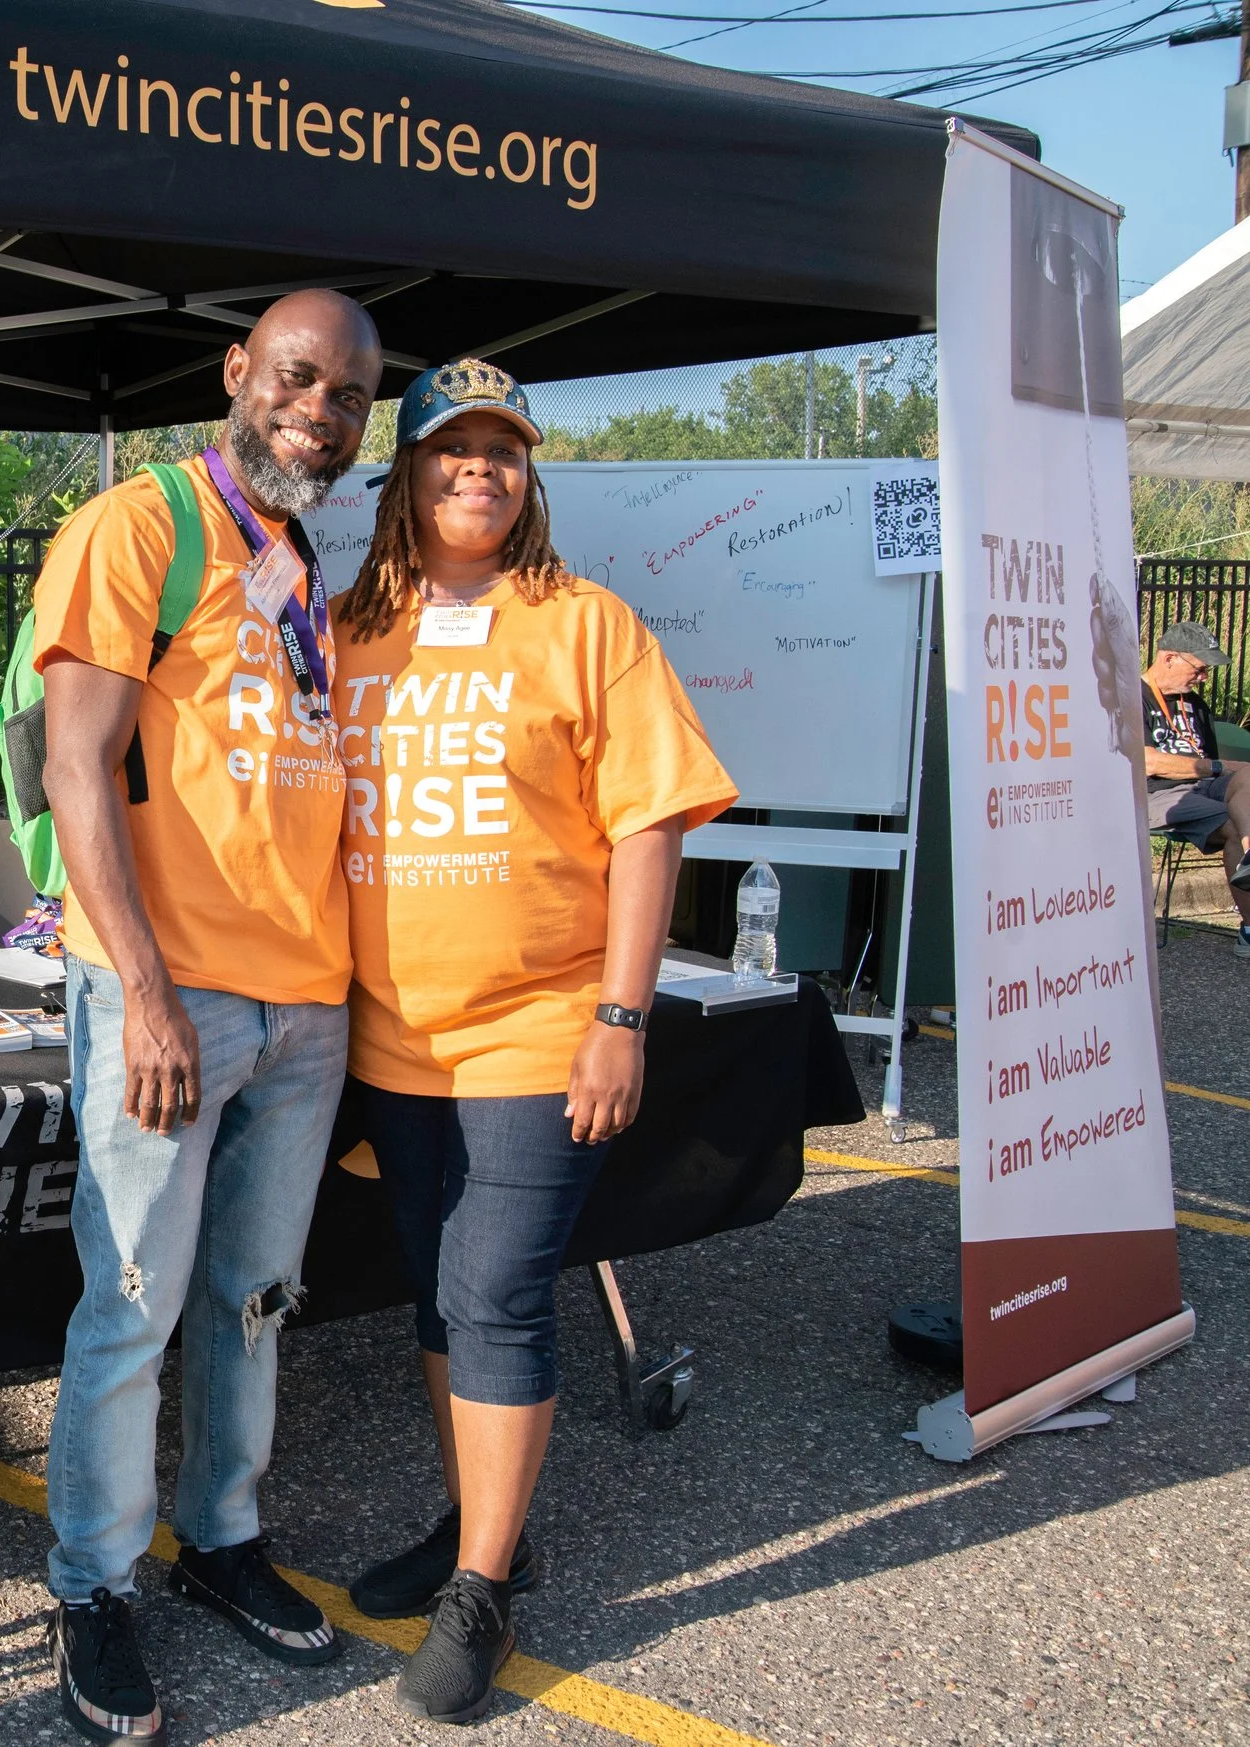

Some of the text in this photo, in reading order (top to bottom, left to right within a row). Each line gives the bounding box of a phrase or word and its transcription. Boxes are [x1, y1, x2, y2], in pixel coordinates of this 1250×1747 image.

[9, 46, 598, 210] twincitiesrise.org
[982, 534, 1065, 605] TWIN
[346, 672, 514, 716] TWIN
[985, 679, 1072, 763] R!SE
[349, 773, 509, 838] R!SE
[1008, 780, 1073, 801] EMPOWERMENT
[1008, 799, 1074, 825] INSTITUTE
[383, 850, 510, 868] EMPOWERMENT
[383, 866, 511, 886] INSTITUTE
[996, 896, 1026, 931] am
[1031, 867, 1116, 925] Loveable
[998, 979, 1028, 1016] am
[1036, 948, 1134, 1009] Important
[999, 1061, 1030, 1099] am
[1037, 1025, 1111, 1085] Valuable
[1000, 1137, 1032, 1177] am
[1041, 1088, 1145, 1162] Empowered
[990, 1275, 1067, 1321] twincitiesrise.org
